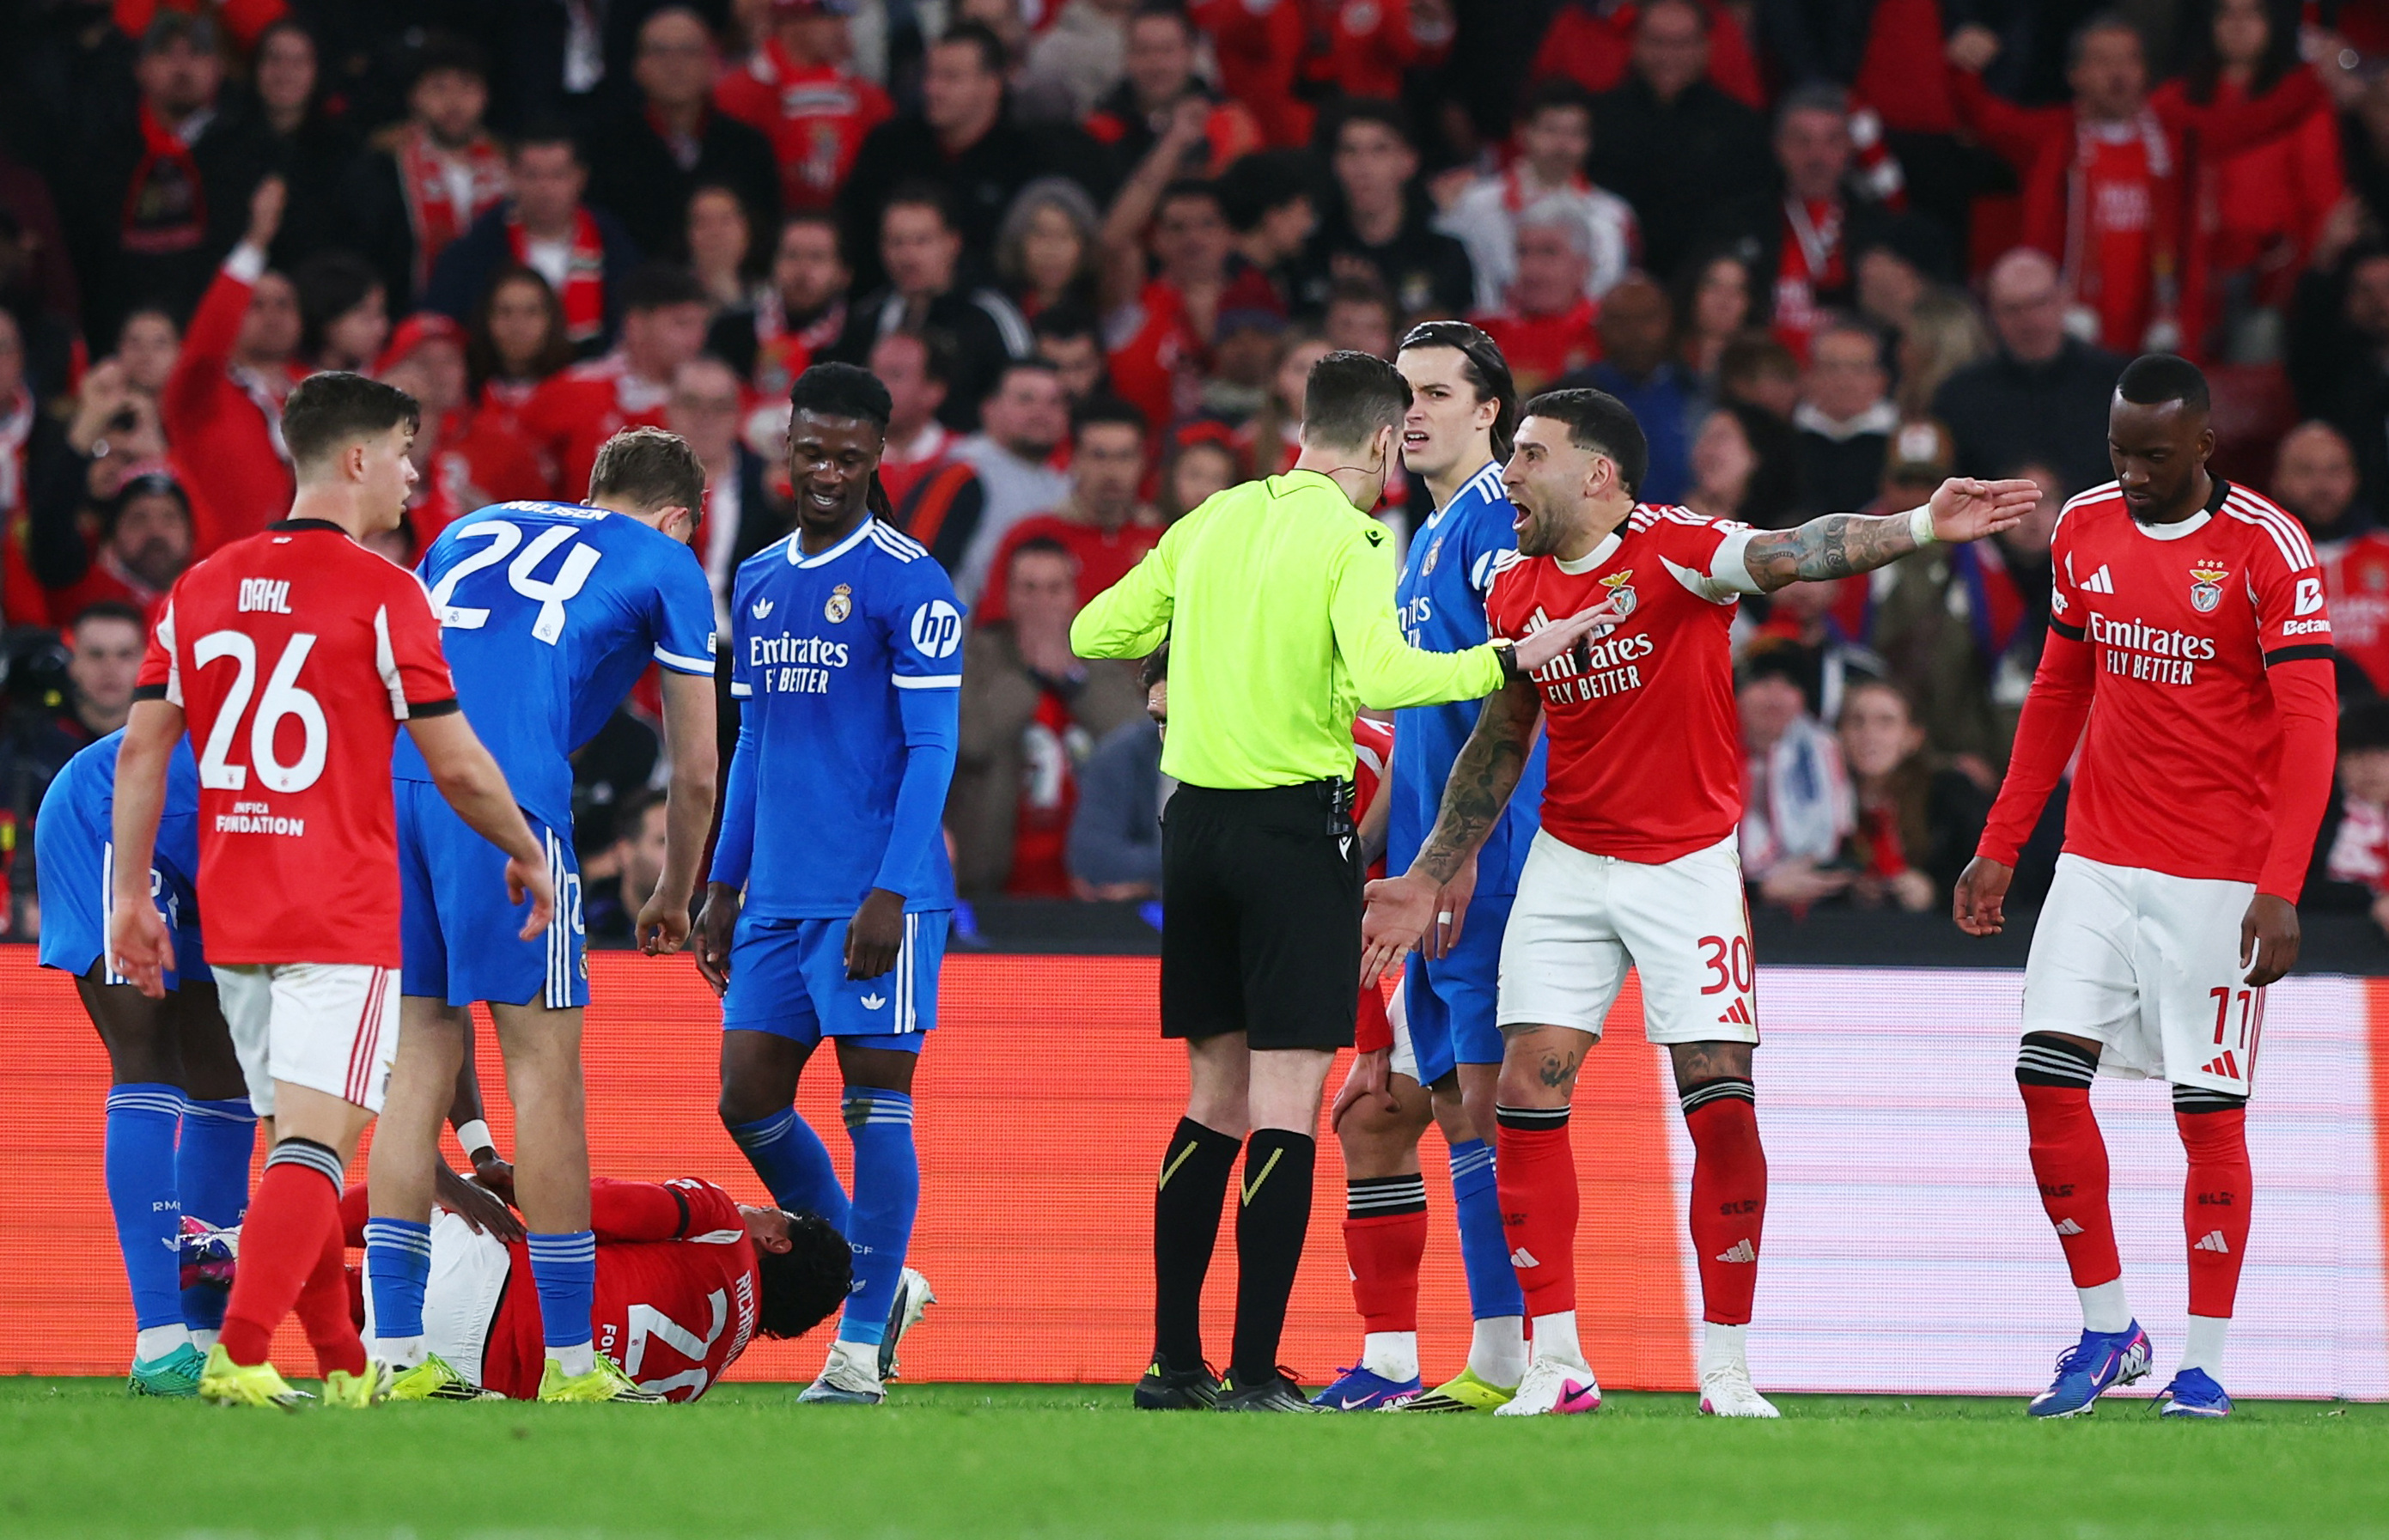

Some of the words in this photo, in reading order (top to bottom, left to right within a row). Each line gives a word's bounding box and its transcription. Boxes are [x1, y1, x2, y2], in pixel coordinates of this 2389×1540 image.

[238, 577, 292, 614] DAHL
[430, 520, 602, 646] 24
[750, 631, 849, 667] Emirates
[914, 600, 959, 658] hp
[2089, 611, 2215, 660] Emirates
[2282, 618, 2332, 636] Betan
[1547, 683, 1574, 704] FLY
[1577, 666, 1642, 701] BETTER
[2106, 649, 2129, 675] FLY
[2132, 654, 2193, 685] BETTER
[193, 630, 328, 794] 26
[1697, 934, 1752, 995] 30
[2209, 986, 2252, 1050] 11
